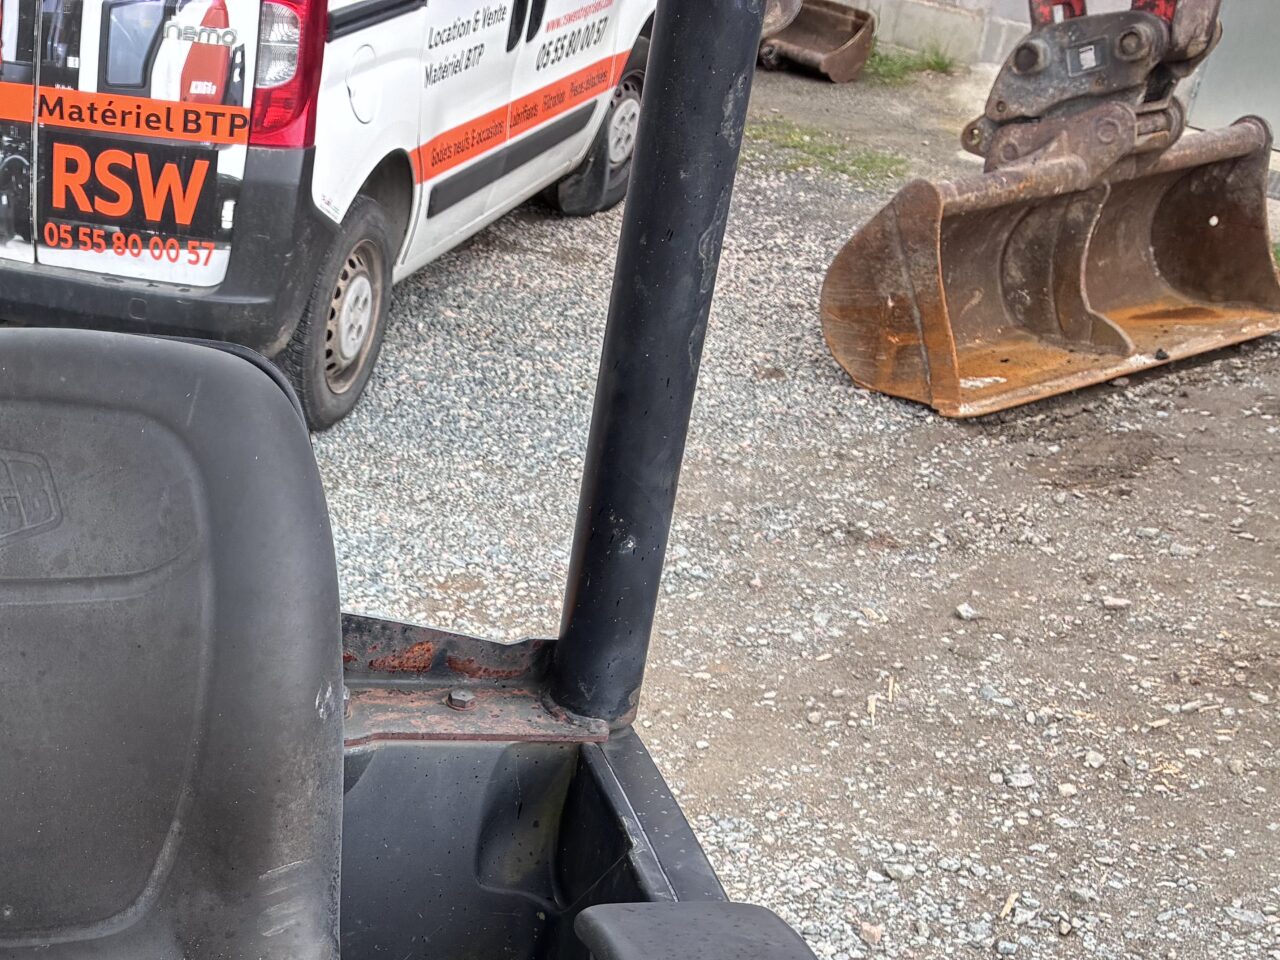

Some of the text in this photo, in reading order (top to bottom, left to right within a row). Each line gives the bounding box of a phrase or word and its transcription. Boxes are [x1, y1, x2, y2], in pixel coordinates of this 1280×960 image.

[163, 20, 238, 46] nemo
[428, 16, 471, 49] Location
[482, 5, 508, 30] Vente
[464, 43, 484, 70] BTP
[38, 94, 249, 137] Matériel BTP
[52, 142, 210, 225] RSW
[44, 222, 215, 266] 05 55 80 00 57
